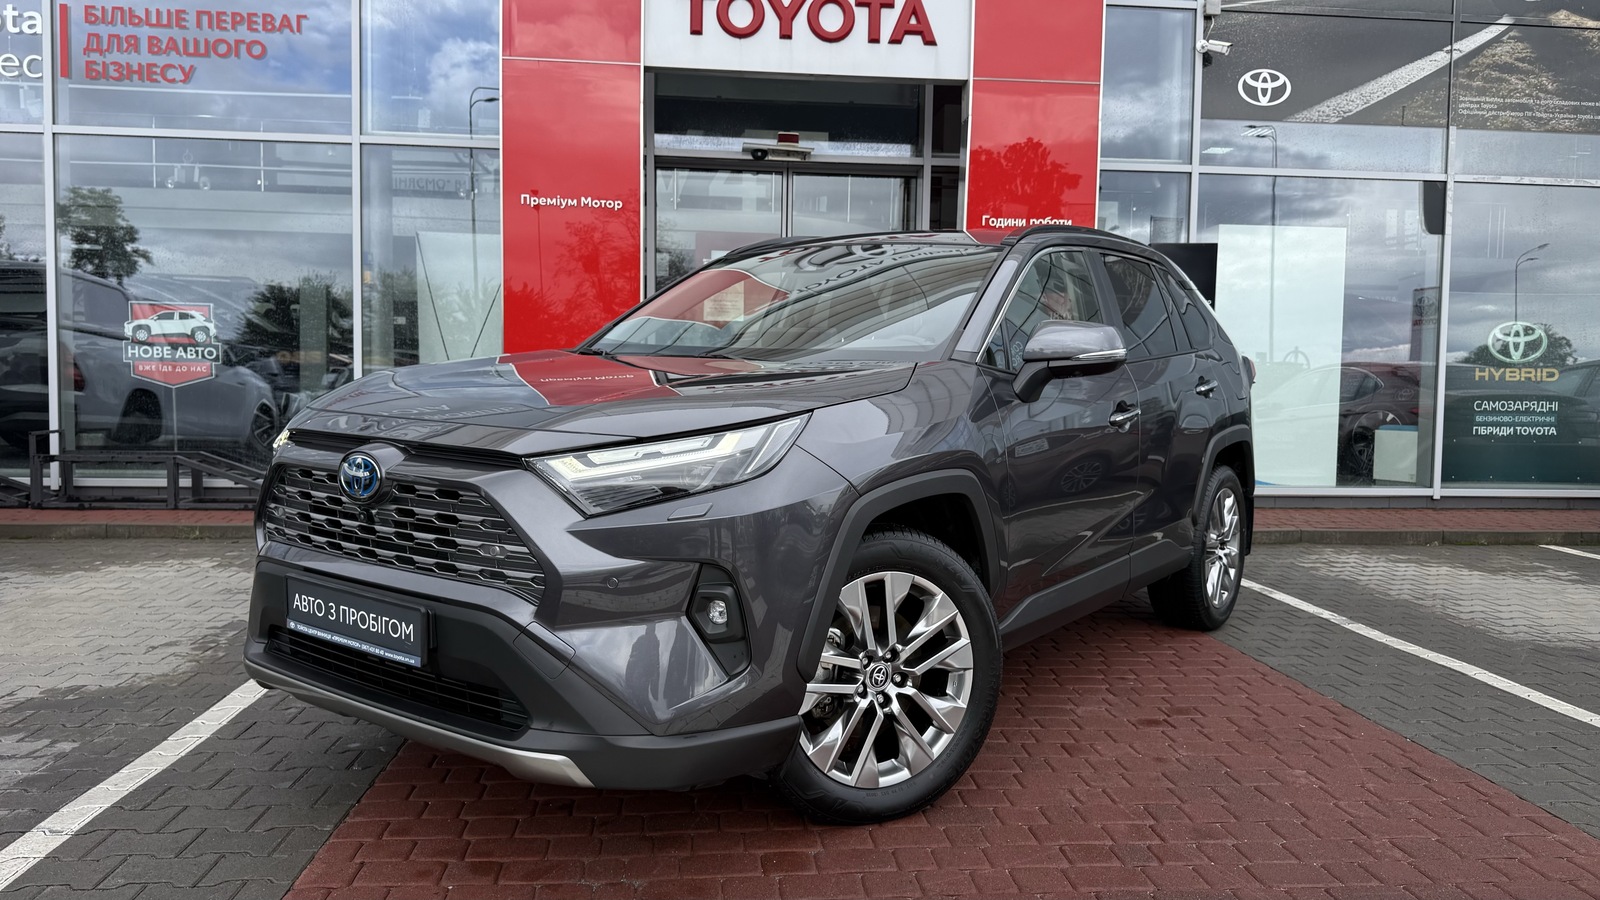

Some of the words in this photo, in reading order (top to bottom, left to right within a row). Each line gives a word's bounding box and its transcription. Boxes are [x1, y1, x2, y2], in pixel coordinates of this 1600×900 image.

[0, 4, 42, 34] ta
[83, 4, 189, 30] БІЛЬШЕ
[196, 9, 309, 34] ПЕРЕВАГ
[686, 0, 938, 46] TOYOTA
[83, 33, 139, 56] ДЛЯ
[147, 35, 267, 60] ВАШОГО
[84, 60, 197, 84] БІЗНЕСУ
[520, 193, 578, 209] Преміум
[581, 196, 623, 211] Мотор
[981, 214, 1027, 229] Години
[127, 345, 172, 359] НОВЕ
[175, 346, 217, 360] АВТО
[138, 364, 156, 372] ВЖЕ
[158, 363, 173, 373] ЇДЕ
[175, 365, 188, 373] ДО
[1474, 367, 1560, 382] HYBRID
[1473, 400, 1559, 413] САМОЗАРЯДНІ
[1472, 426, 1514, 437] ГІБРИДИ
[1515, 426, 1557, 436] TOYOTA
[293, 592, 326, 617] АВТО
[339, 605, 415, 642] ПРОБІГОМ
